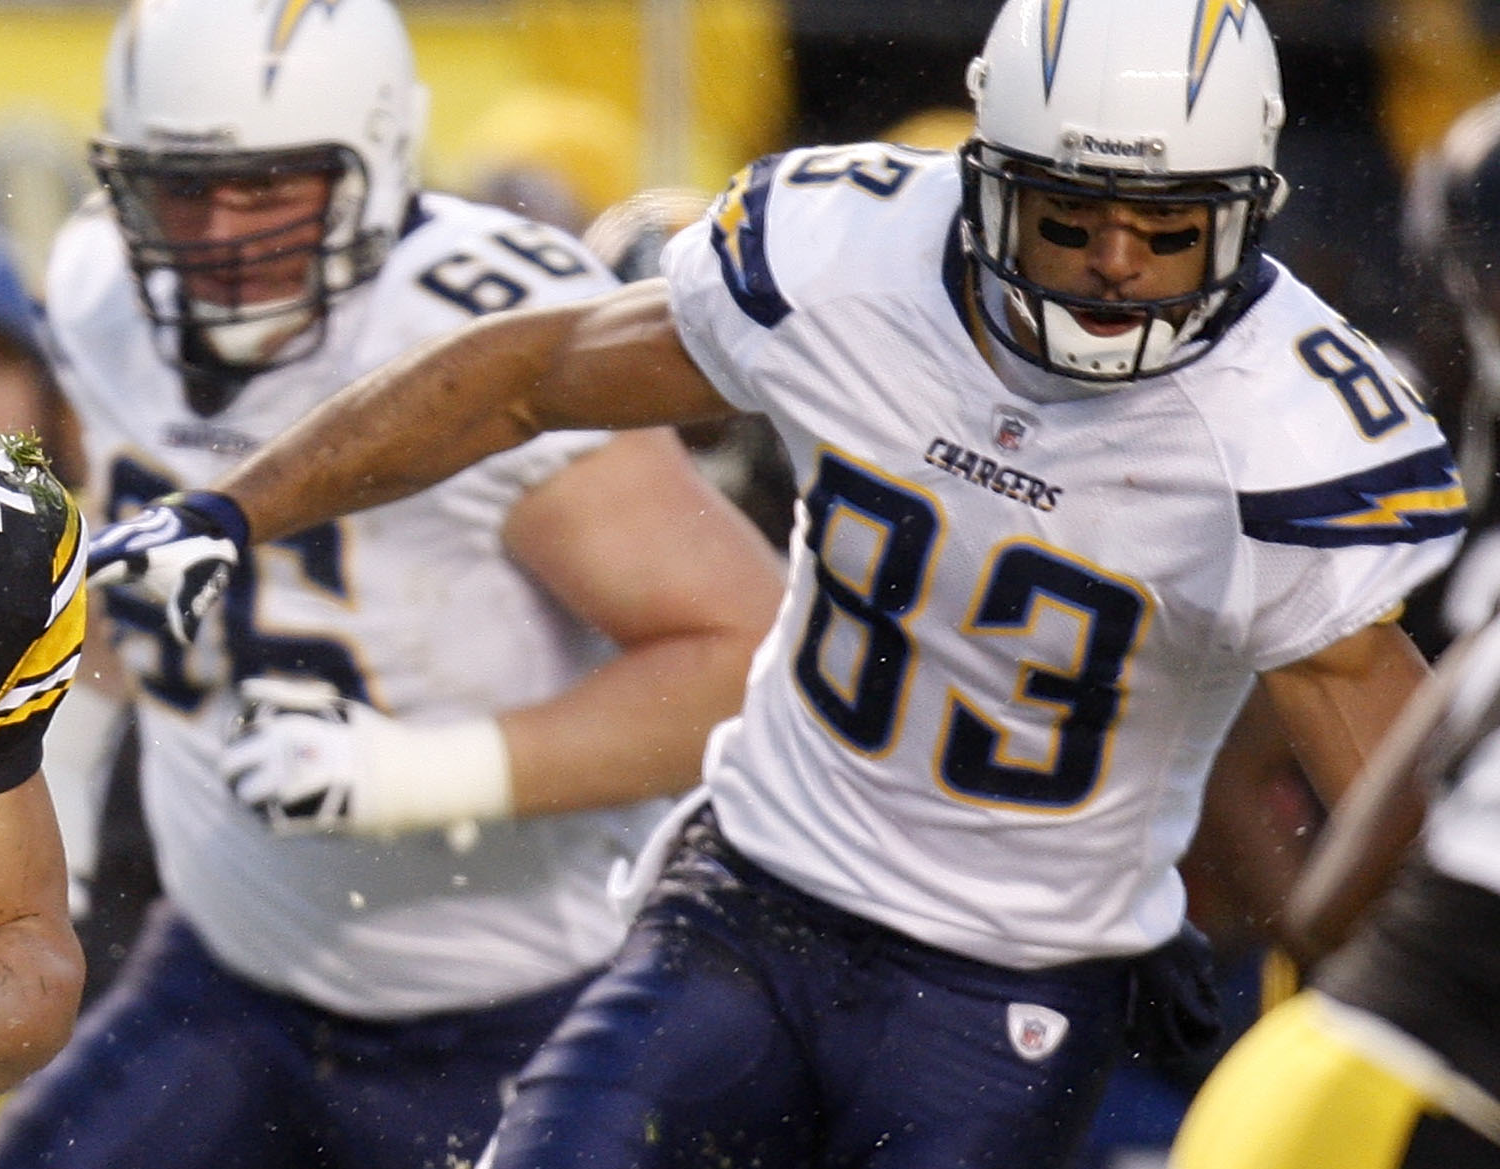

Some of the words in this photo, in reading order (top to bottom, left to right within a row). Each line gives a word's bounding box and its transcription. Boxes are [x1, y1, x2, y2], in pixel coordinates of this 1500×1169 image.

[1083, 134, 1145, 156] Riddell
[923, 436, 1066, 513] CHARGERS
[790, 443, 1155, 816] 83
